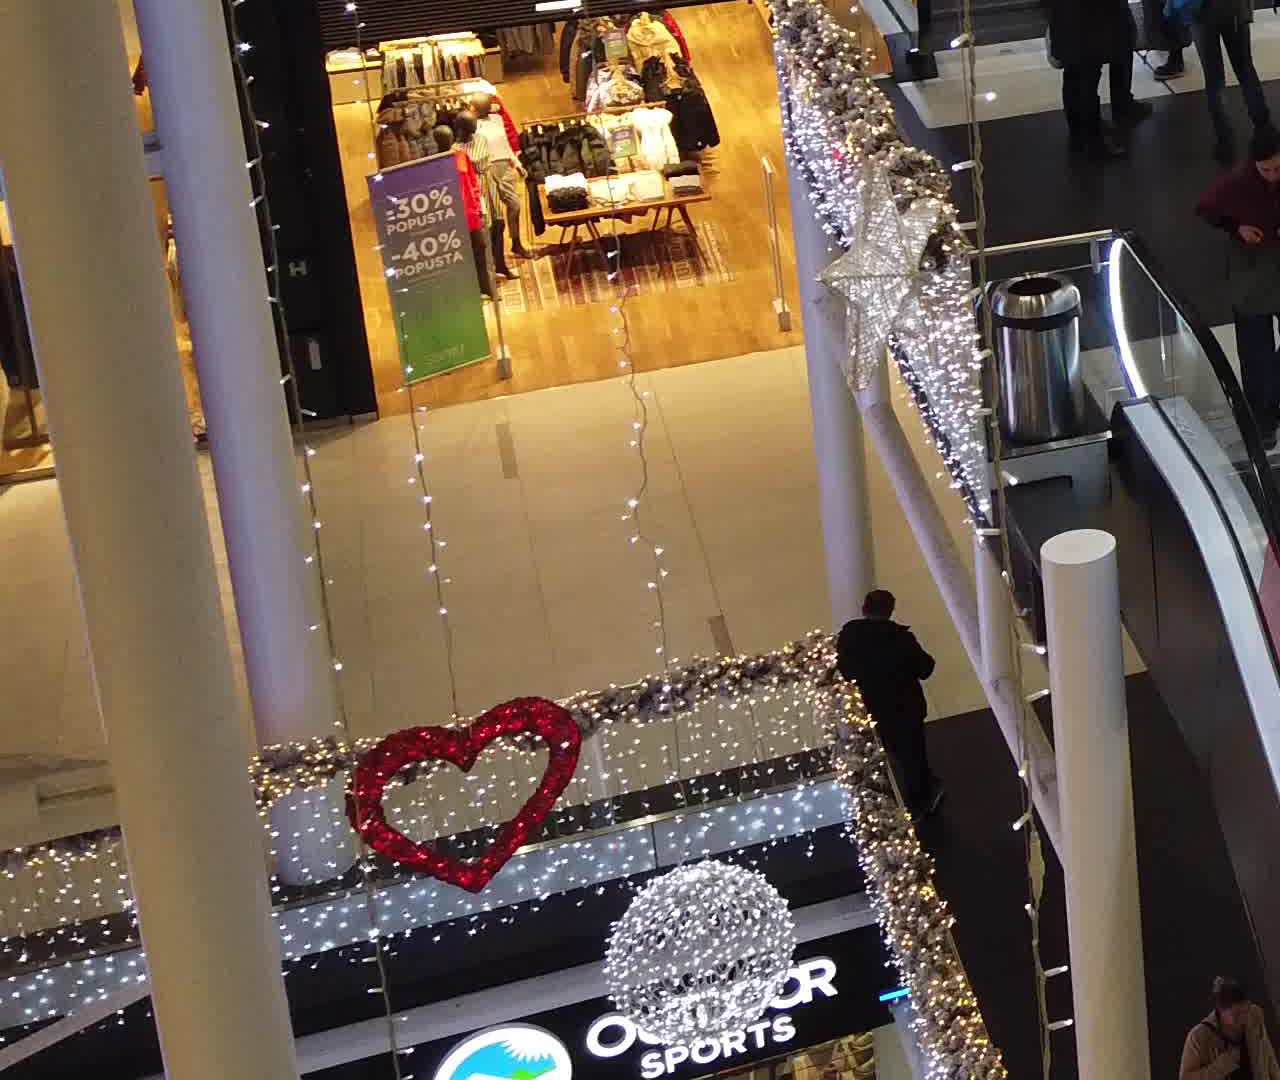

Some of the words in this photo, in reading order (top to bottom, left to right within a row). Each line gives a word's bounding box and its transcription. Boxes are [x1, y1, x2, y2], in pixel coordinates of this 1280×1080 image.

[386, 207, 456, 235] POPUSTA
[392, 229, 461, 261] -40%
[394, 251, 464, 280] POPUSTA
[640, 1015, 797, 1080] SPORTS
